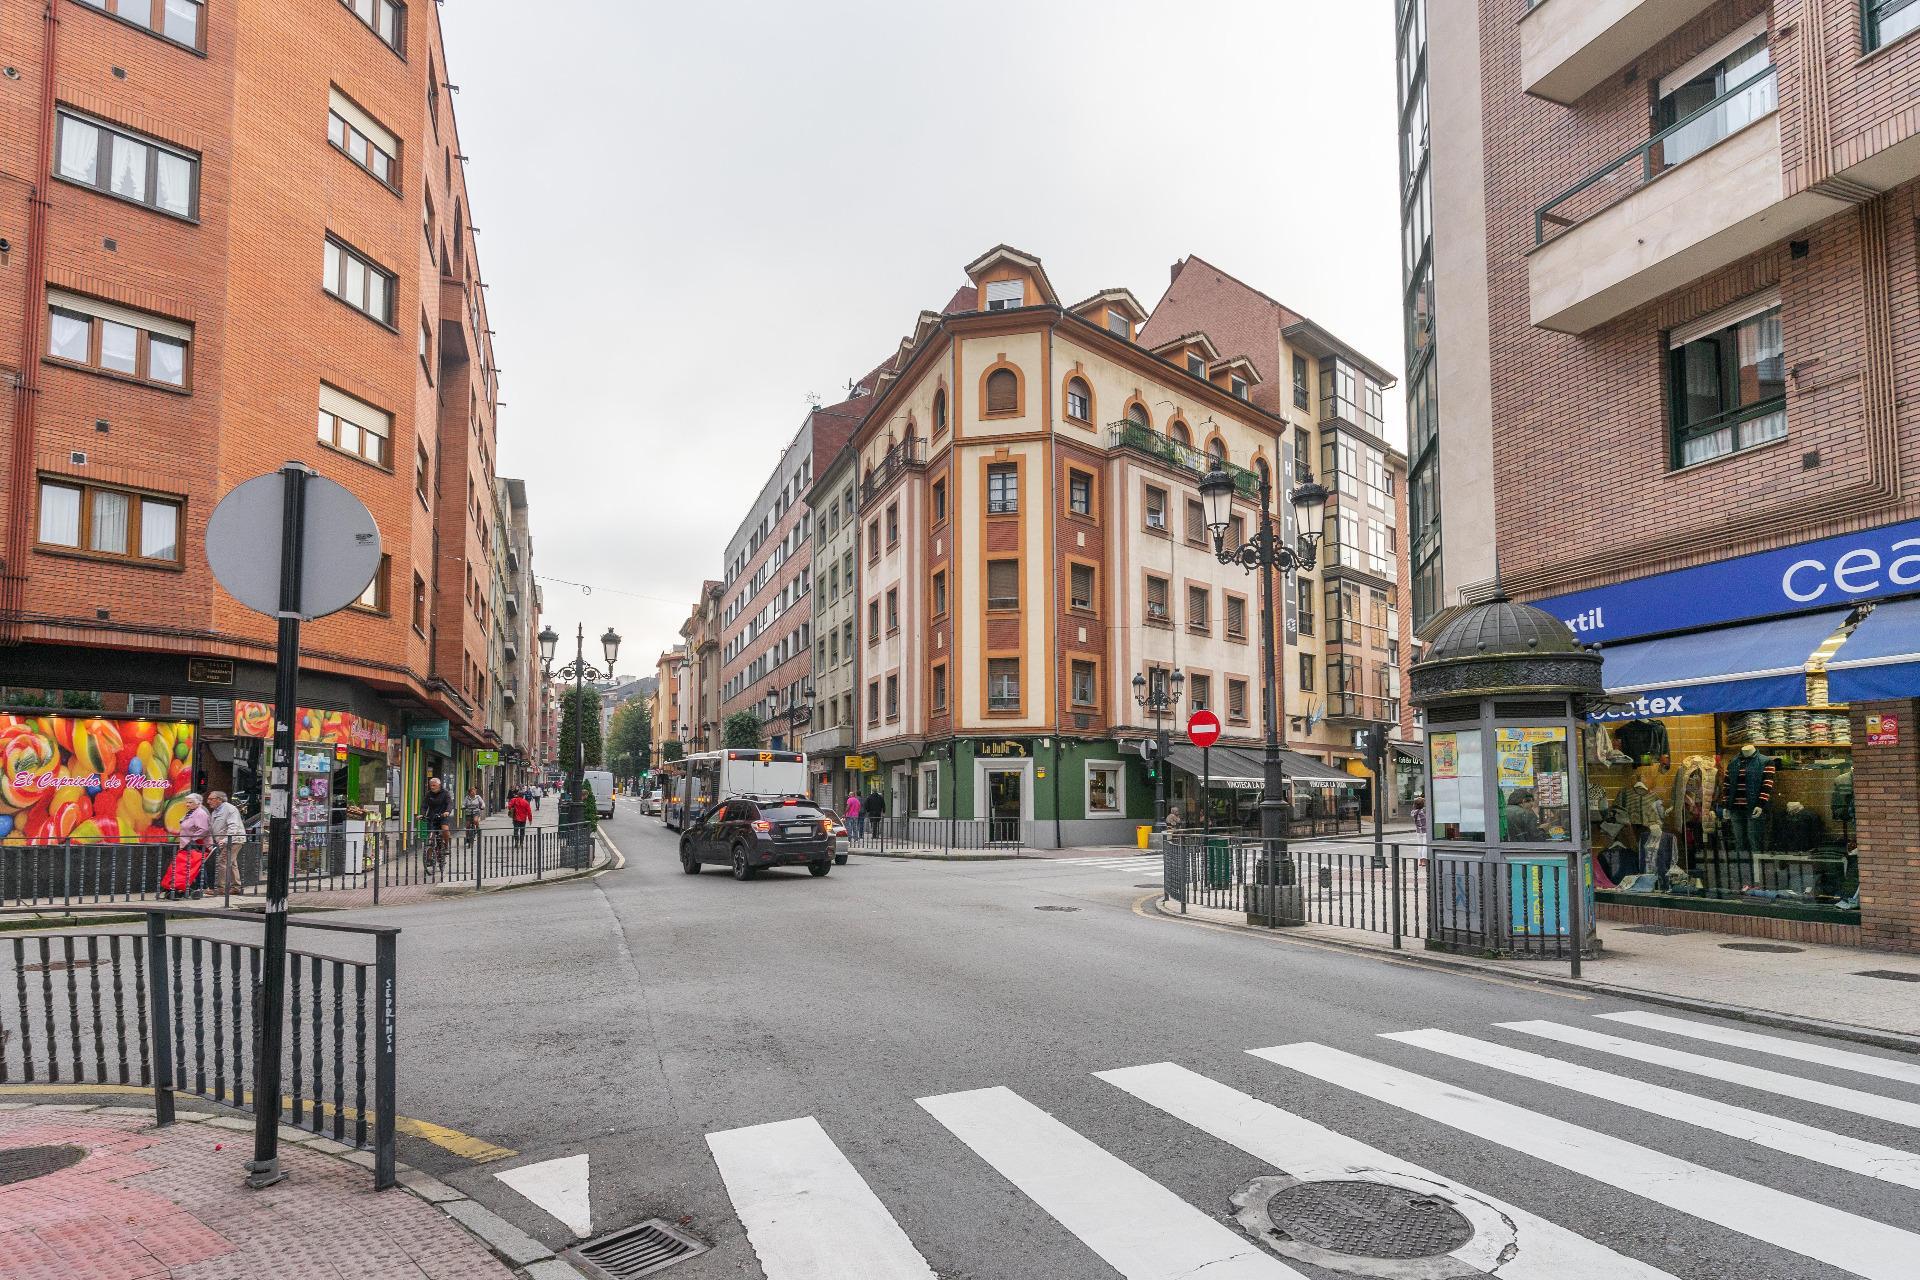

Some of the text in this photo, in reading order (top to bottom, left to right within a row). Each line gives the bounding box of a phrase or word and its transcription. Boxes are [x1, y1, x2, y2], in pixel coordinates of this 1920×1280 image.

[982, 742, 990, 754] La
[1501, 743, 1529, 752] 11/11
[760, 752, 772, 761] E2
[14, 771, 33, 787] El
[37, 771, 101, 789] Capricho
[105, 774, 121, 787] de
[1227, 781, 1251, 789] VINOTECA
